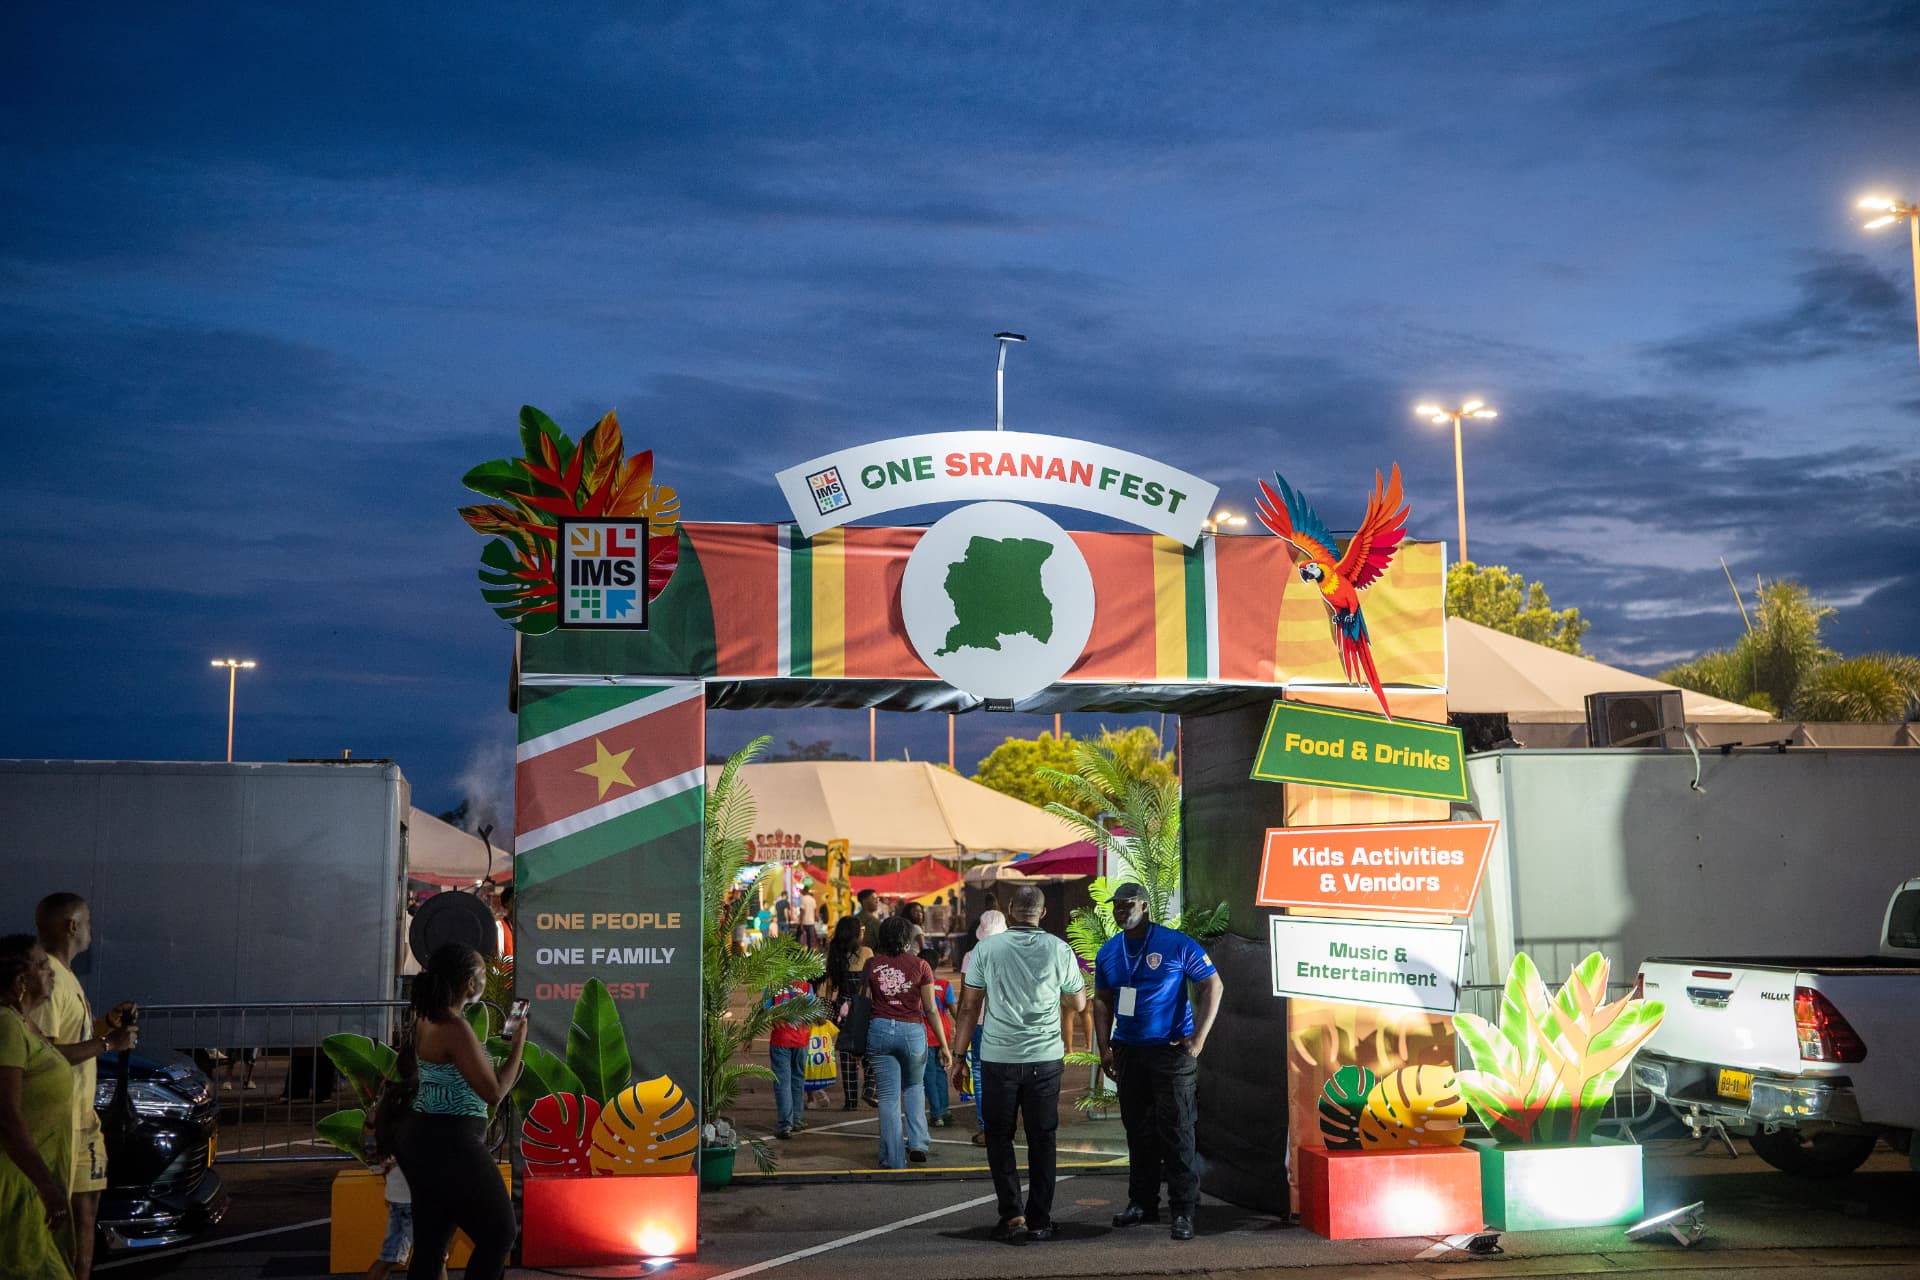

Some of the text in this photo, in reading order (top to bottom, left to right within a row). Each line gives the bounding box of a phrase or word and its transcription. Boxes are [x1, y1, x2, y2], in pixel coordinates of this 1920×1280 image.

[815, 483, 841, 499] IMS
[861, 452, 1188, 514] ONE SRANAN FEST
[570, 559, 636, 587] IMS
[1285, 733, 1451, 771] Food & Drinks
[757, 848, 802, 861] KIDS AREA
[1292, 846, 1465, 867] Kids Activities
[1319, 872, 1440, 893] & Vendors
[536, 912, 681, 930] ONE PEOPLE
[536, 947, 676, 965] ONE FAMILY
[1329, 942, 1408, 963] Music &
[1297, 962, 1437, 987] Entertainment
[535, 982, 650, 1000] ONE EST
[1760, 991, 1791, 1002] HILUX
